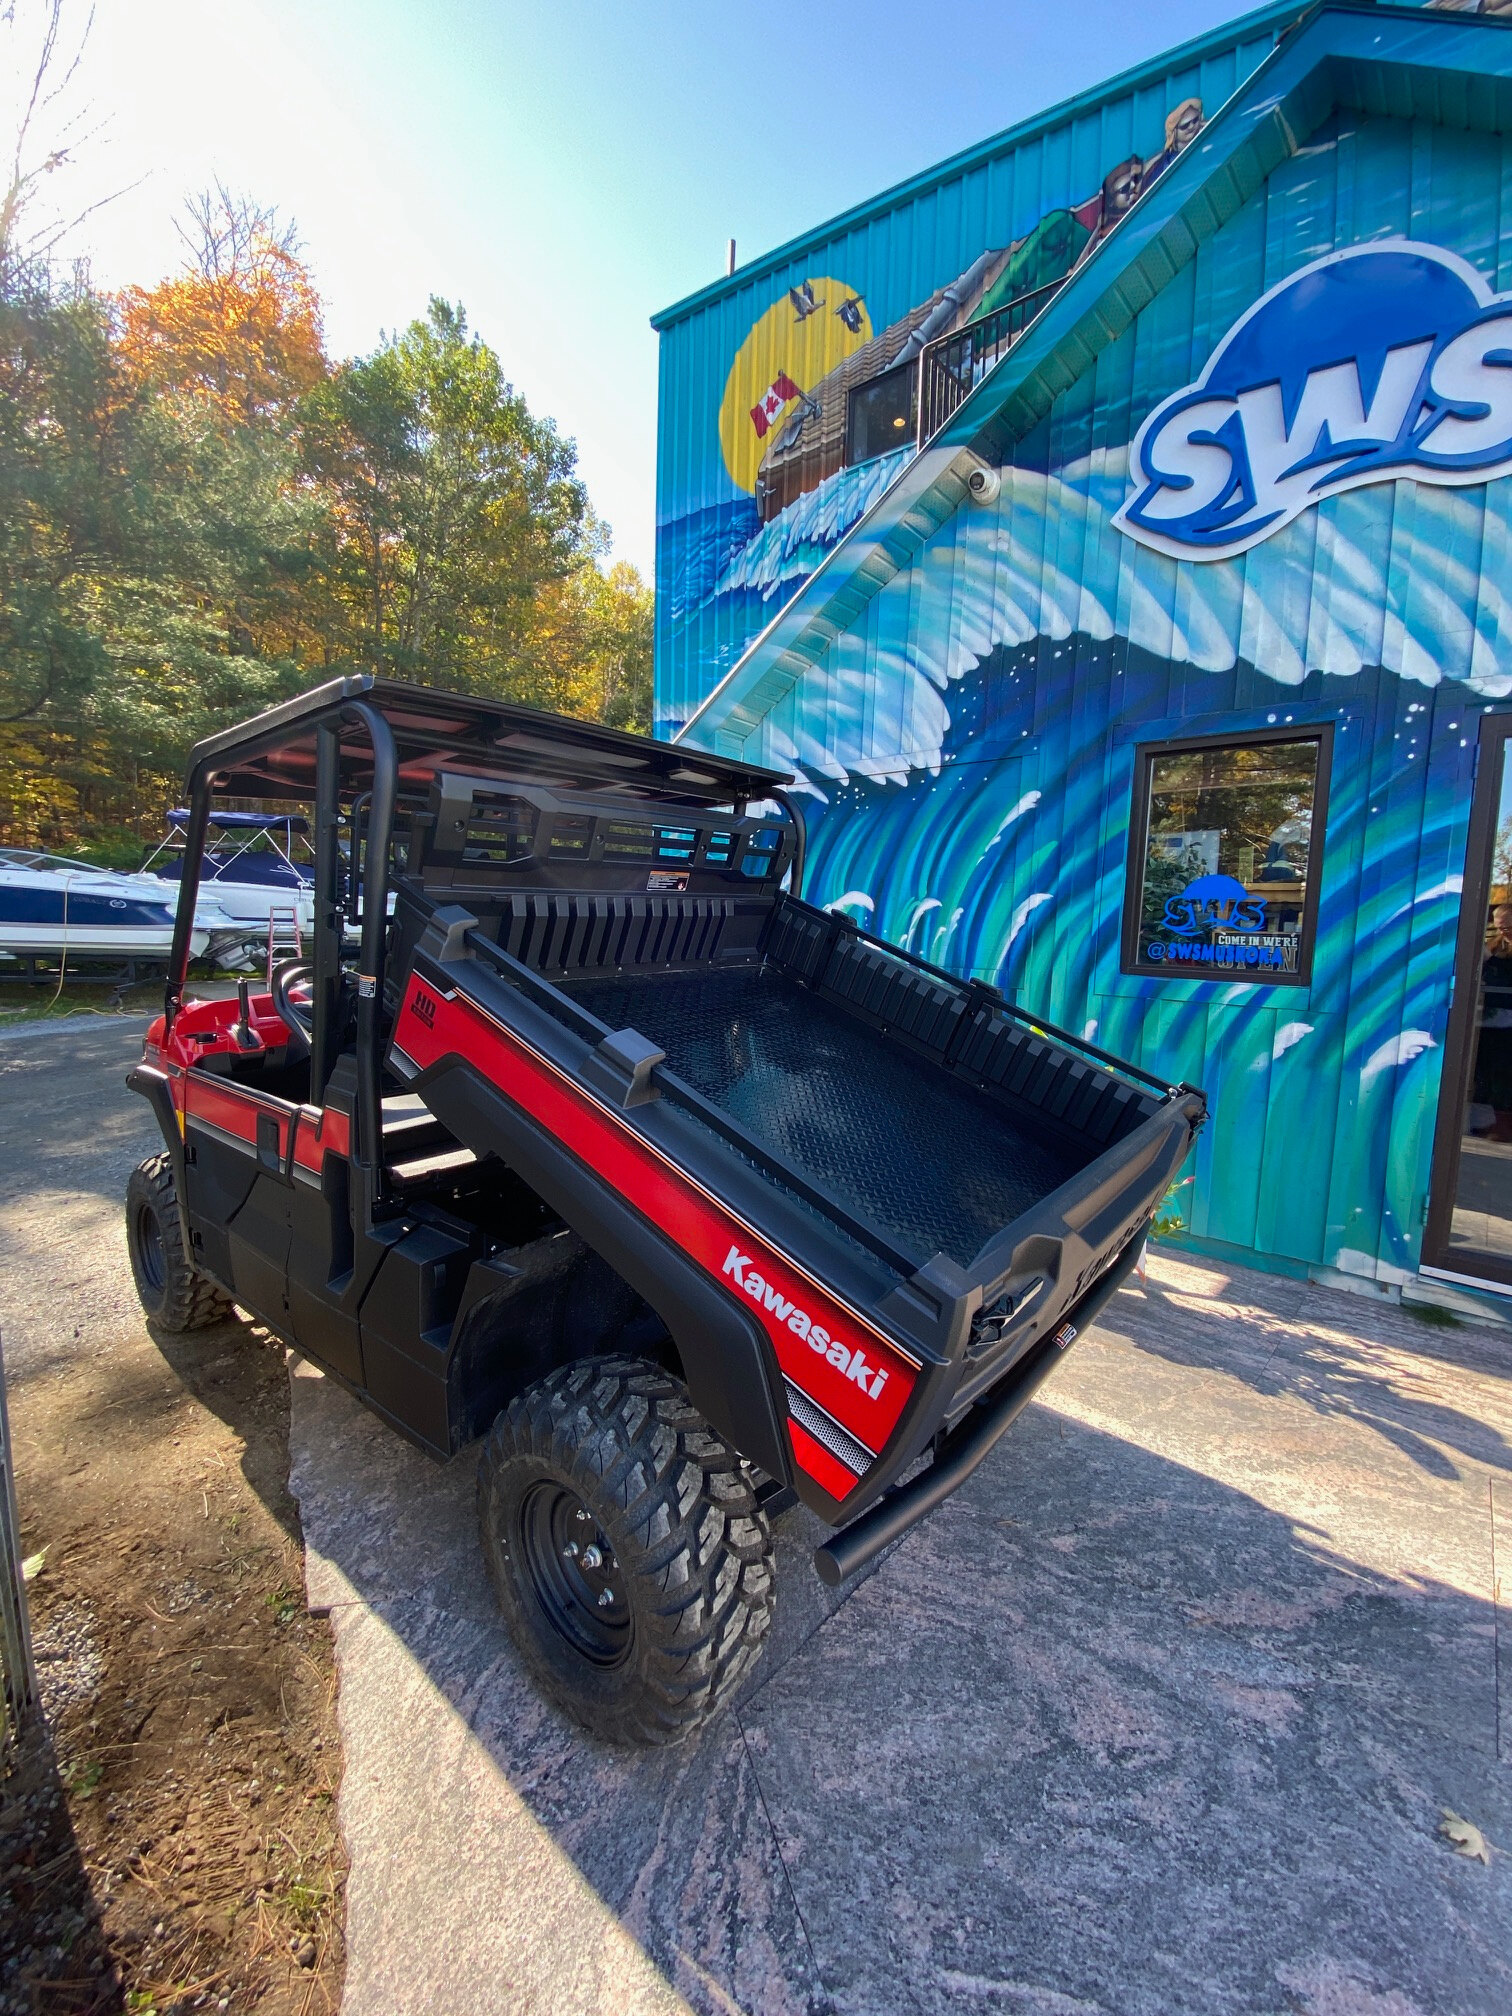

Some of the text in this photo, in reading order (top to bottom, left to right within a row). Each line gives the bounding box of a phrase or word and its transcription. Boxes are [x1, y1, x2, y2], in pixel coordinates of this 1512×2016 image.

[1133, 312, 1512, 526] SWS
[1162, 897, 1267, 936] SWS
[1218, 935, 1298, 947] COME IN WE'RE
[721, 1245, 890, 1401] Kawasaki
